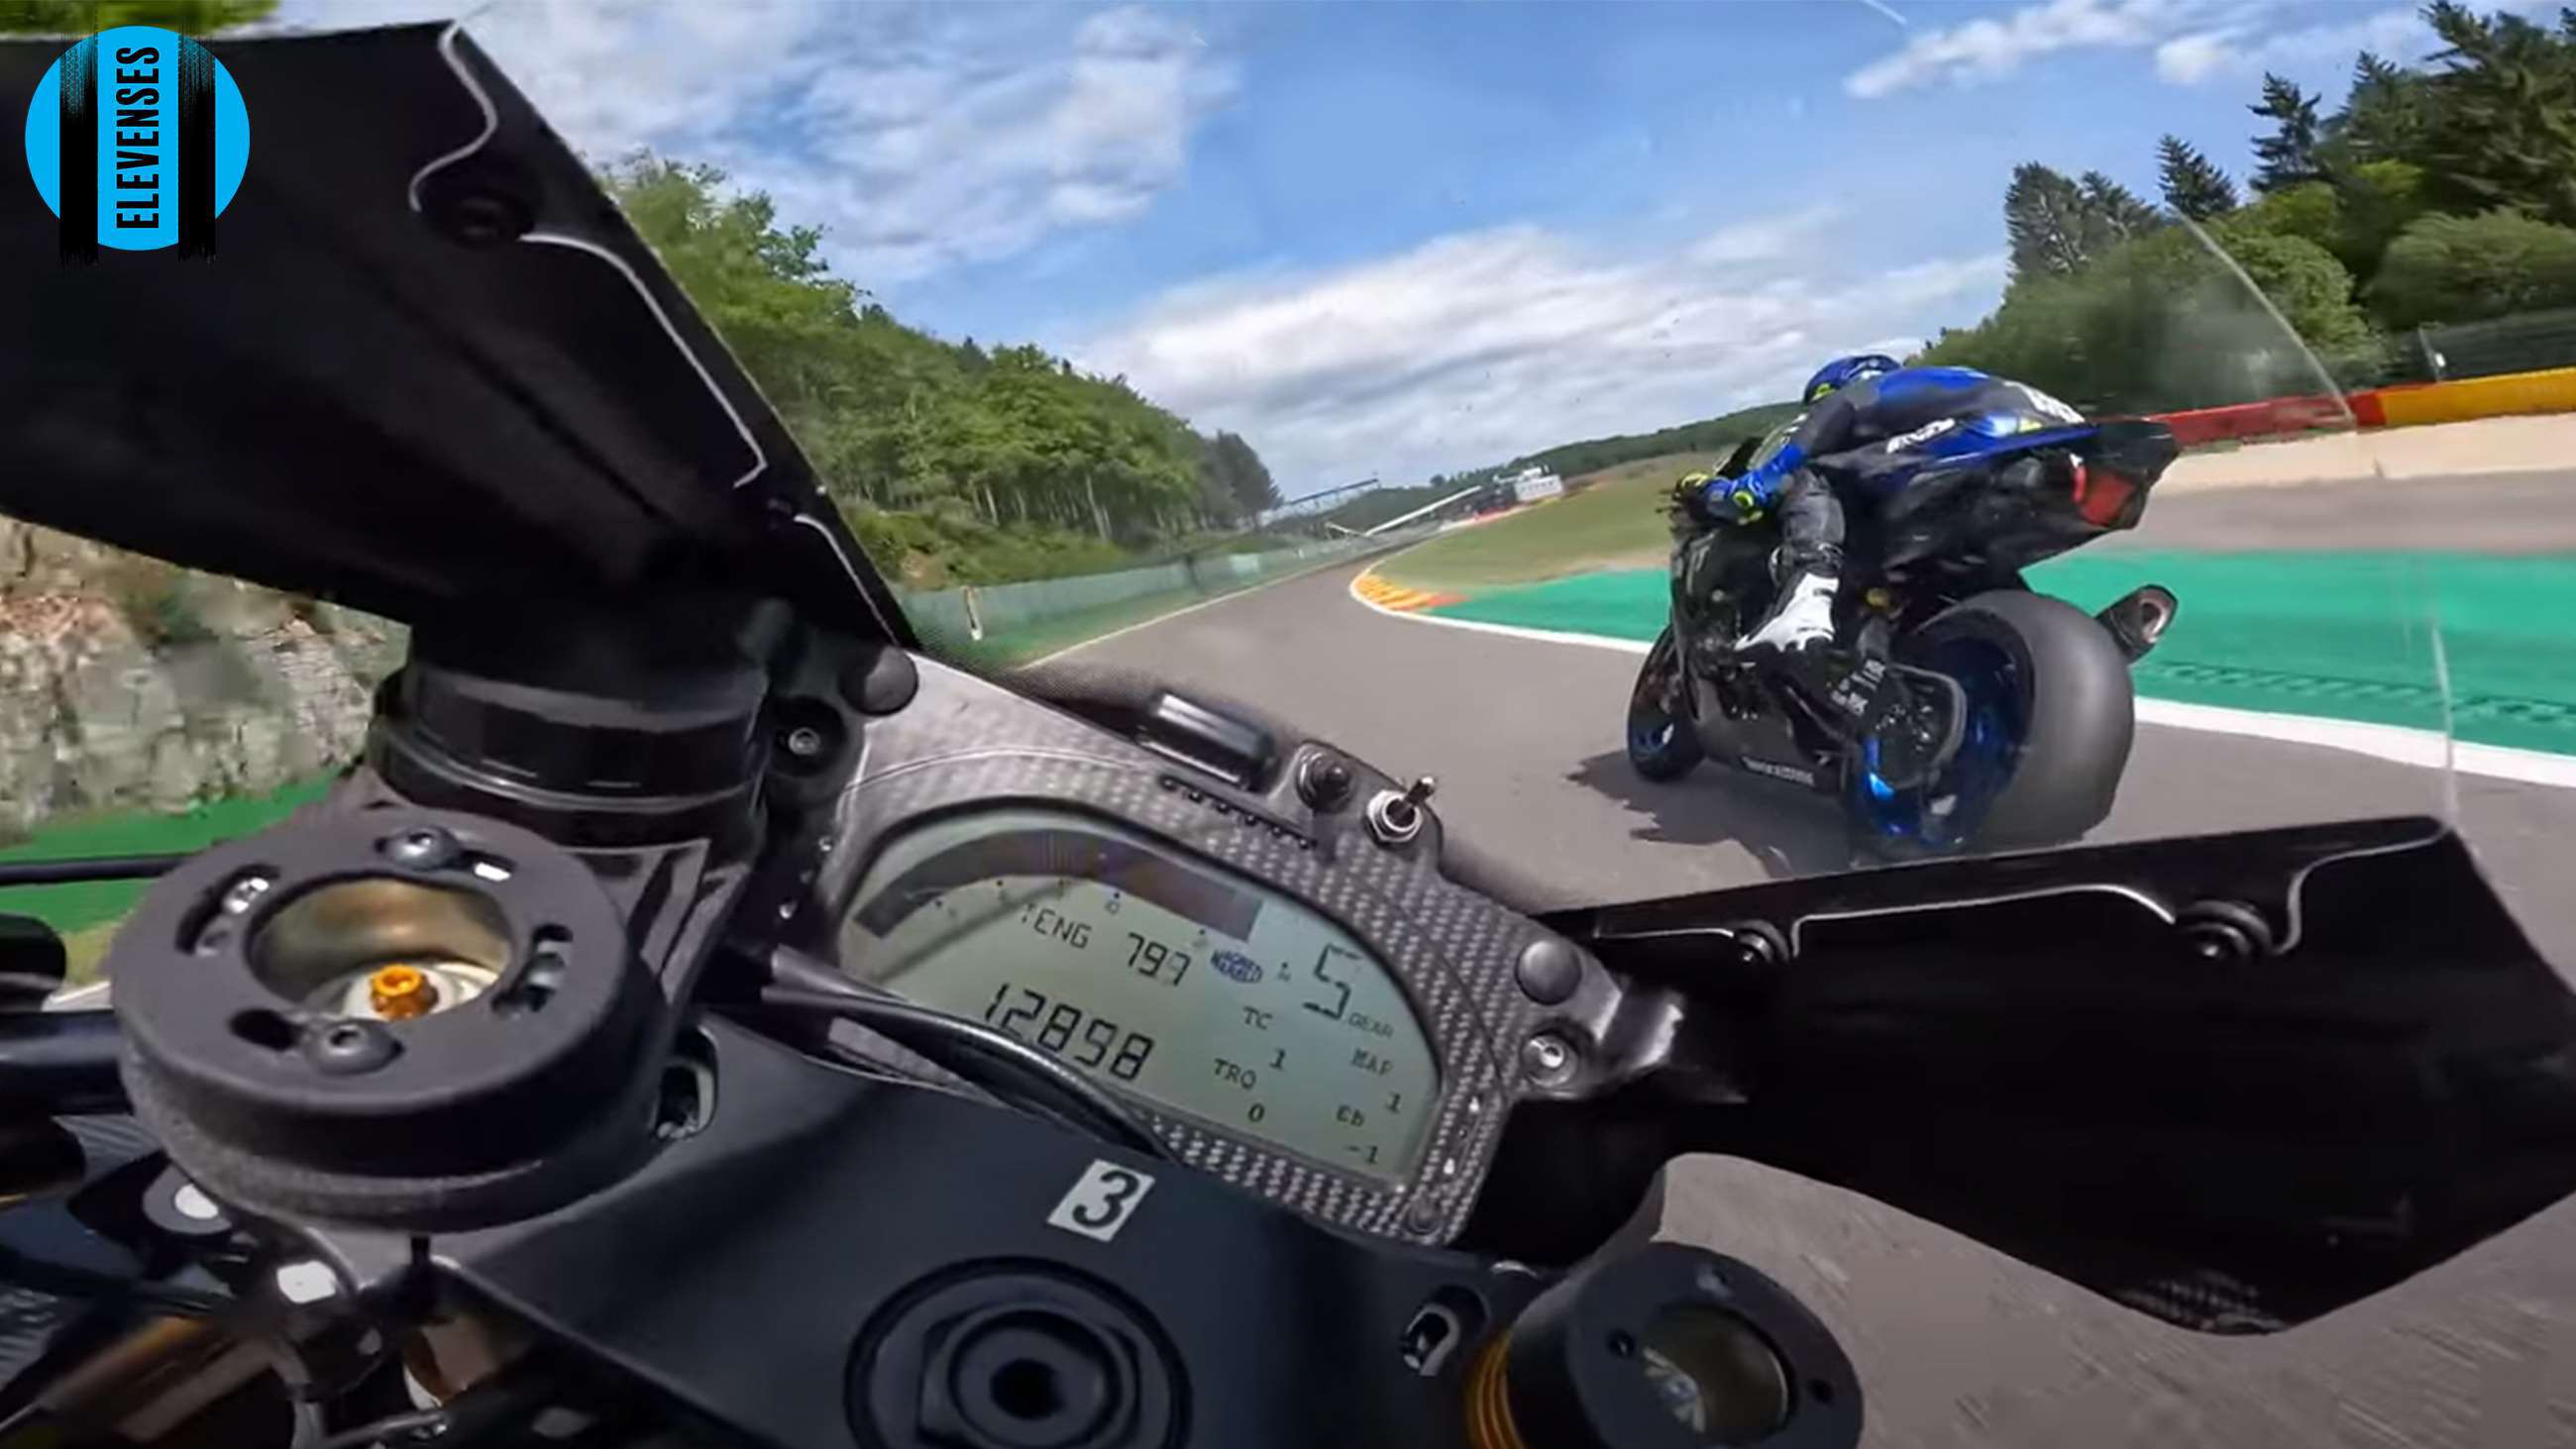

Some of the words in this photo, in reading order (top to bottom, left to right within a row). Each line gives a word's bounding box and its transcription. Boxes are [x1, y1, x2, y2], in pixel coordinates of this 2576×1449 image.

[1242, 1005, 1273, 1030] TC
[1269, 1048, 1286, 1071] 1
[1350, 1048, 1394, 1077] MAP
[1386, 1092, 1401, 1113] 1
[1072, 1170, 1139, 1230] 3
